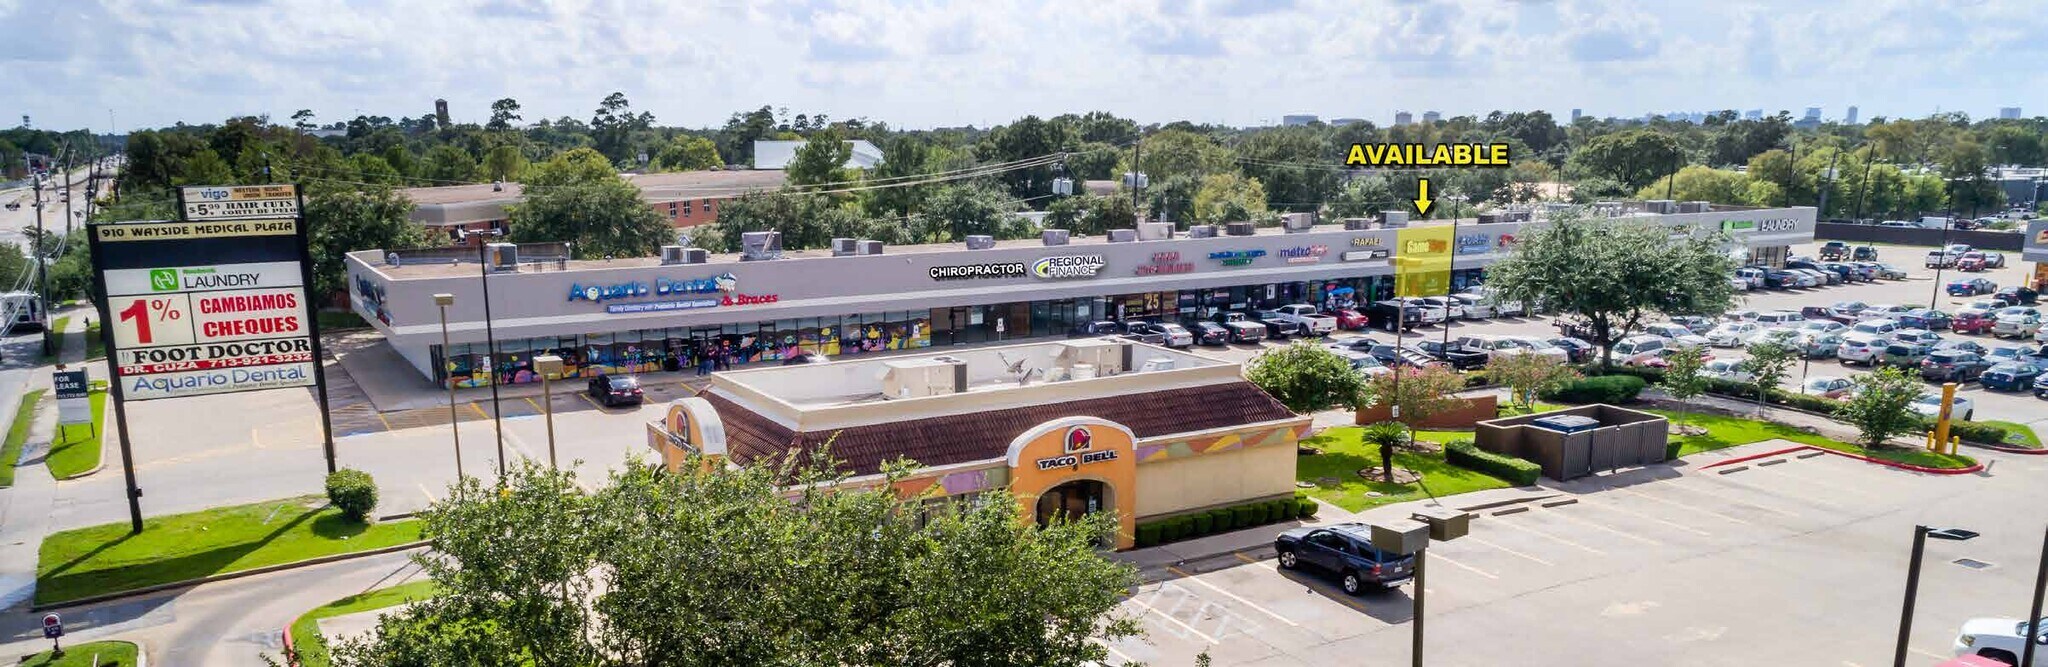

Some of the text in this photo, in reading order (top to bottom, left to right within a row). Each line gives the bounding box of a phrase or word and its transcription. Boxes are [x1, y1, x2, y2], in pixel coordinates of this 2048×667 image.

[201, 188, 229, 200] vigo
[226, 200, 293, 210] HAIR CUTS
[102, 222, 293, 237] 910 WAYSIDE MEDICAL PLAZA
[1760, 218, 1799, 232] LAUNDRY
[1406, 239, 1447, 254] Game
[1049, 256, 1104, 267] REGIONAL
[930, 263, 1025, 278] CHIROPRACTOR
[1049, 265, 1096, 276] FINANCE
[184, 273, 260, 289] LAUNDRY
[569, 275, 721, 303] Aquario Dental
[200, 293, 297, 314] CAMBIAMOS
[721, 295, 734, 306] &
[738, 293, 778, 305] Braces
[203, 316, 299, 338] CHEQUES
[133, 338, 311, 365] FOOT DOCTOR
[123, 353, 312, 375] DR. CUZA 713-921-3232
[56, 382, 79, 390] LEASE
[133, 372, 228, 393] Aquario
[232, 367, 307, 383] Dental
[1038, 450, 1118, 470] TACO BELL
